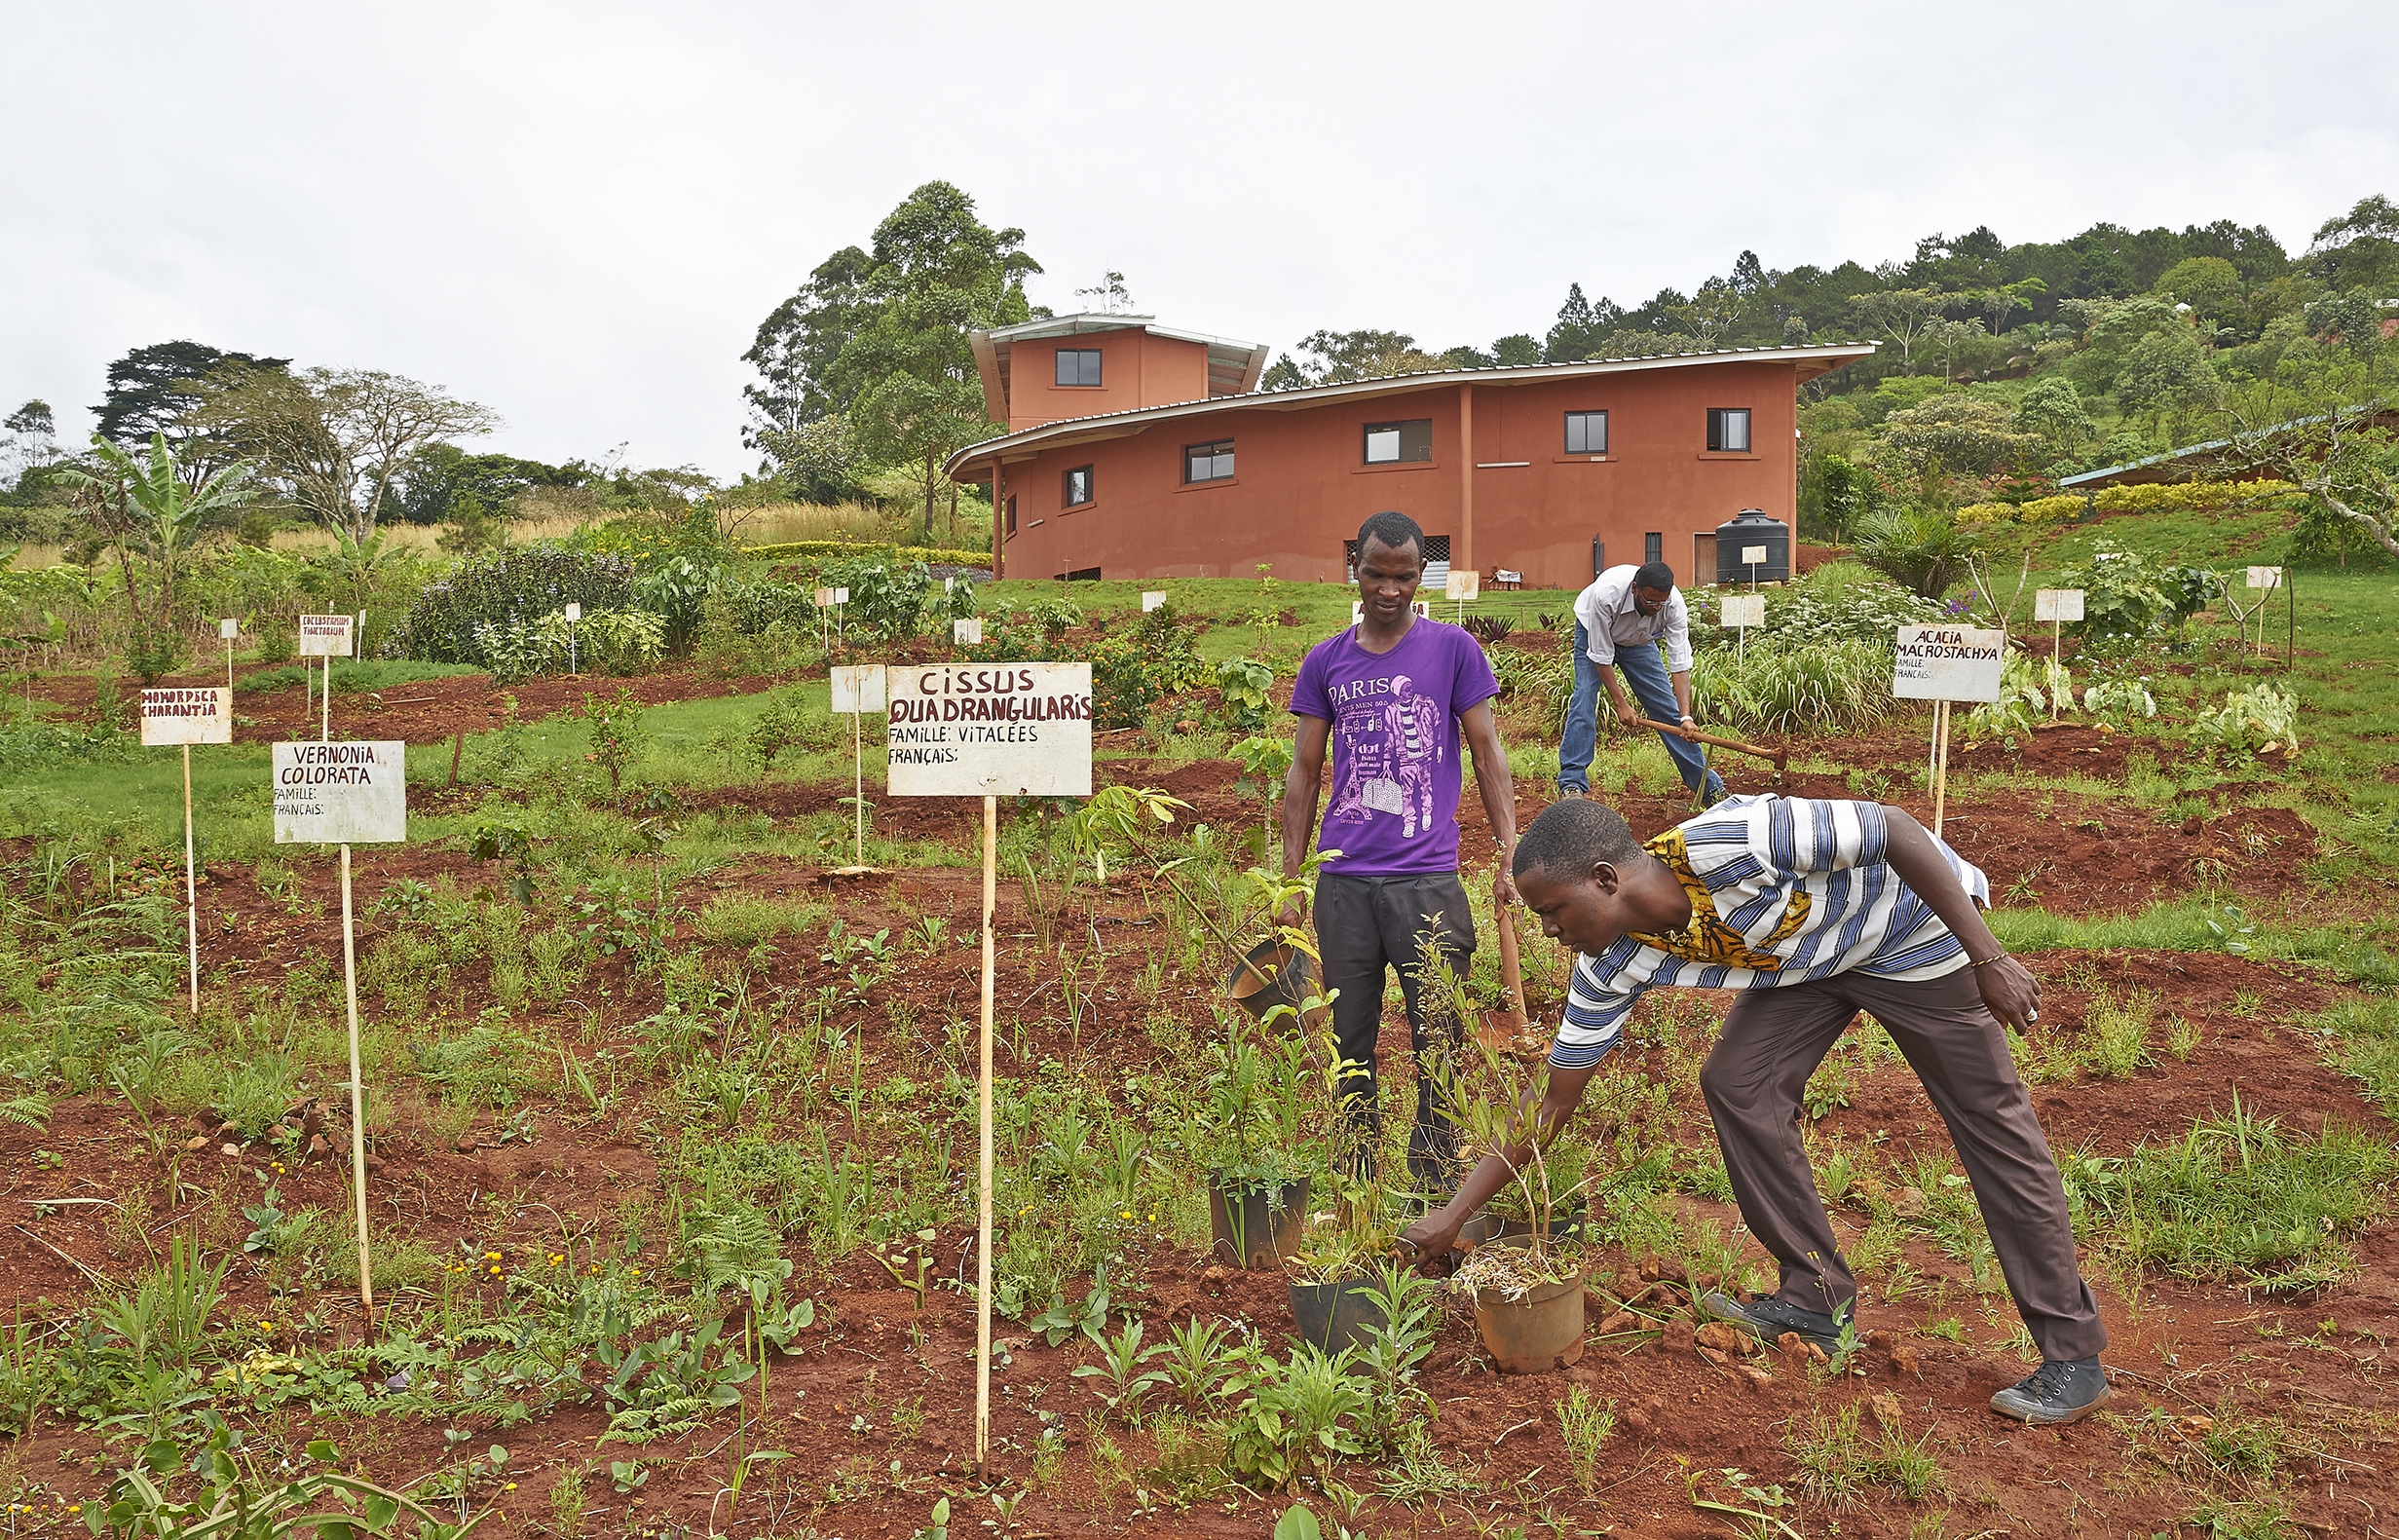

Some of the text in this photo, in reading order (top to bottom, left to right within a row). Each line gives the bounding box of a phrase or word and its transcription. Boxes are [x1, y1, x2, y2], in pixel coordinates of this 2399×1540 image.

[1896, 644, 1998, 660] MACROSTACHYA
[1328, 677, 1390, 711] PARIS
[281, 767, 372, 785] COLORATA
